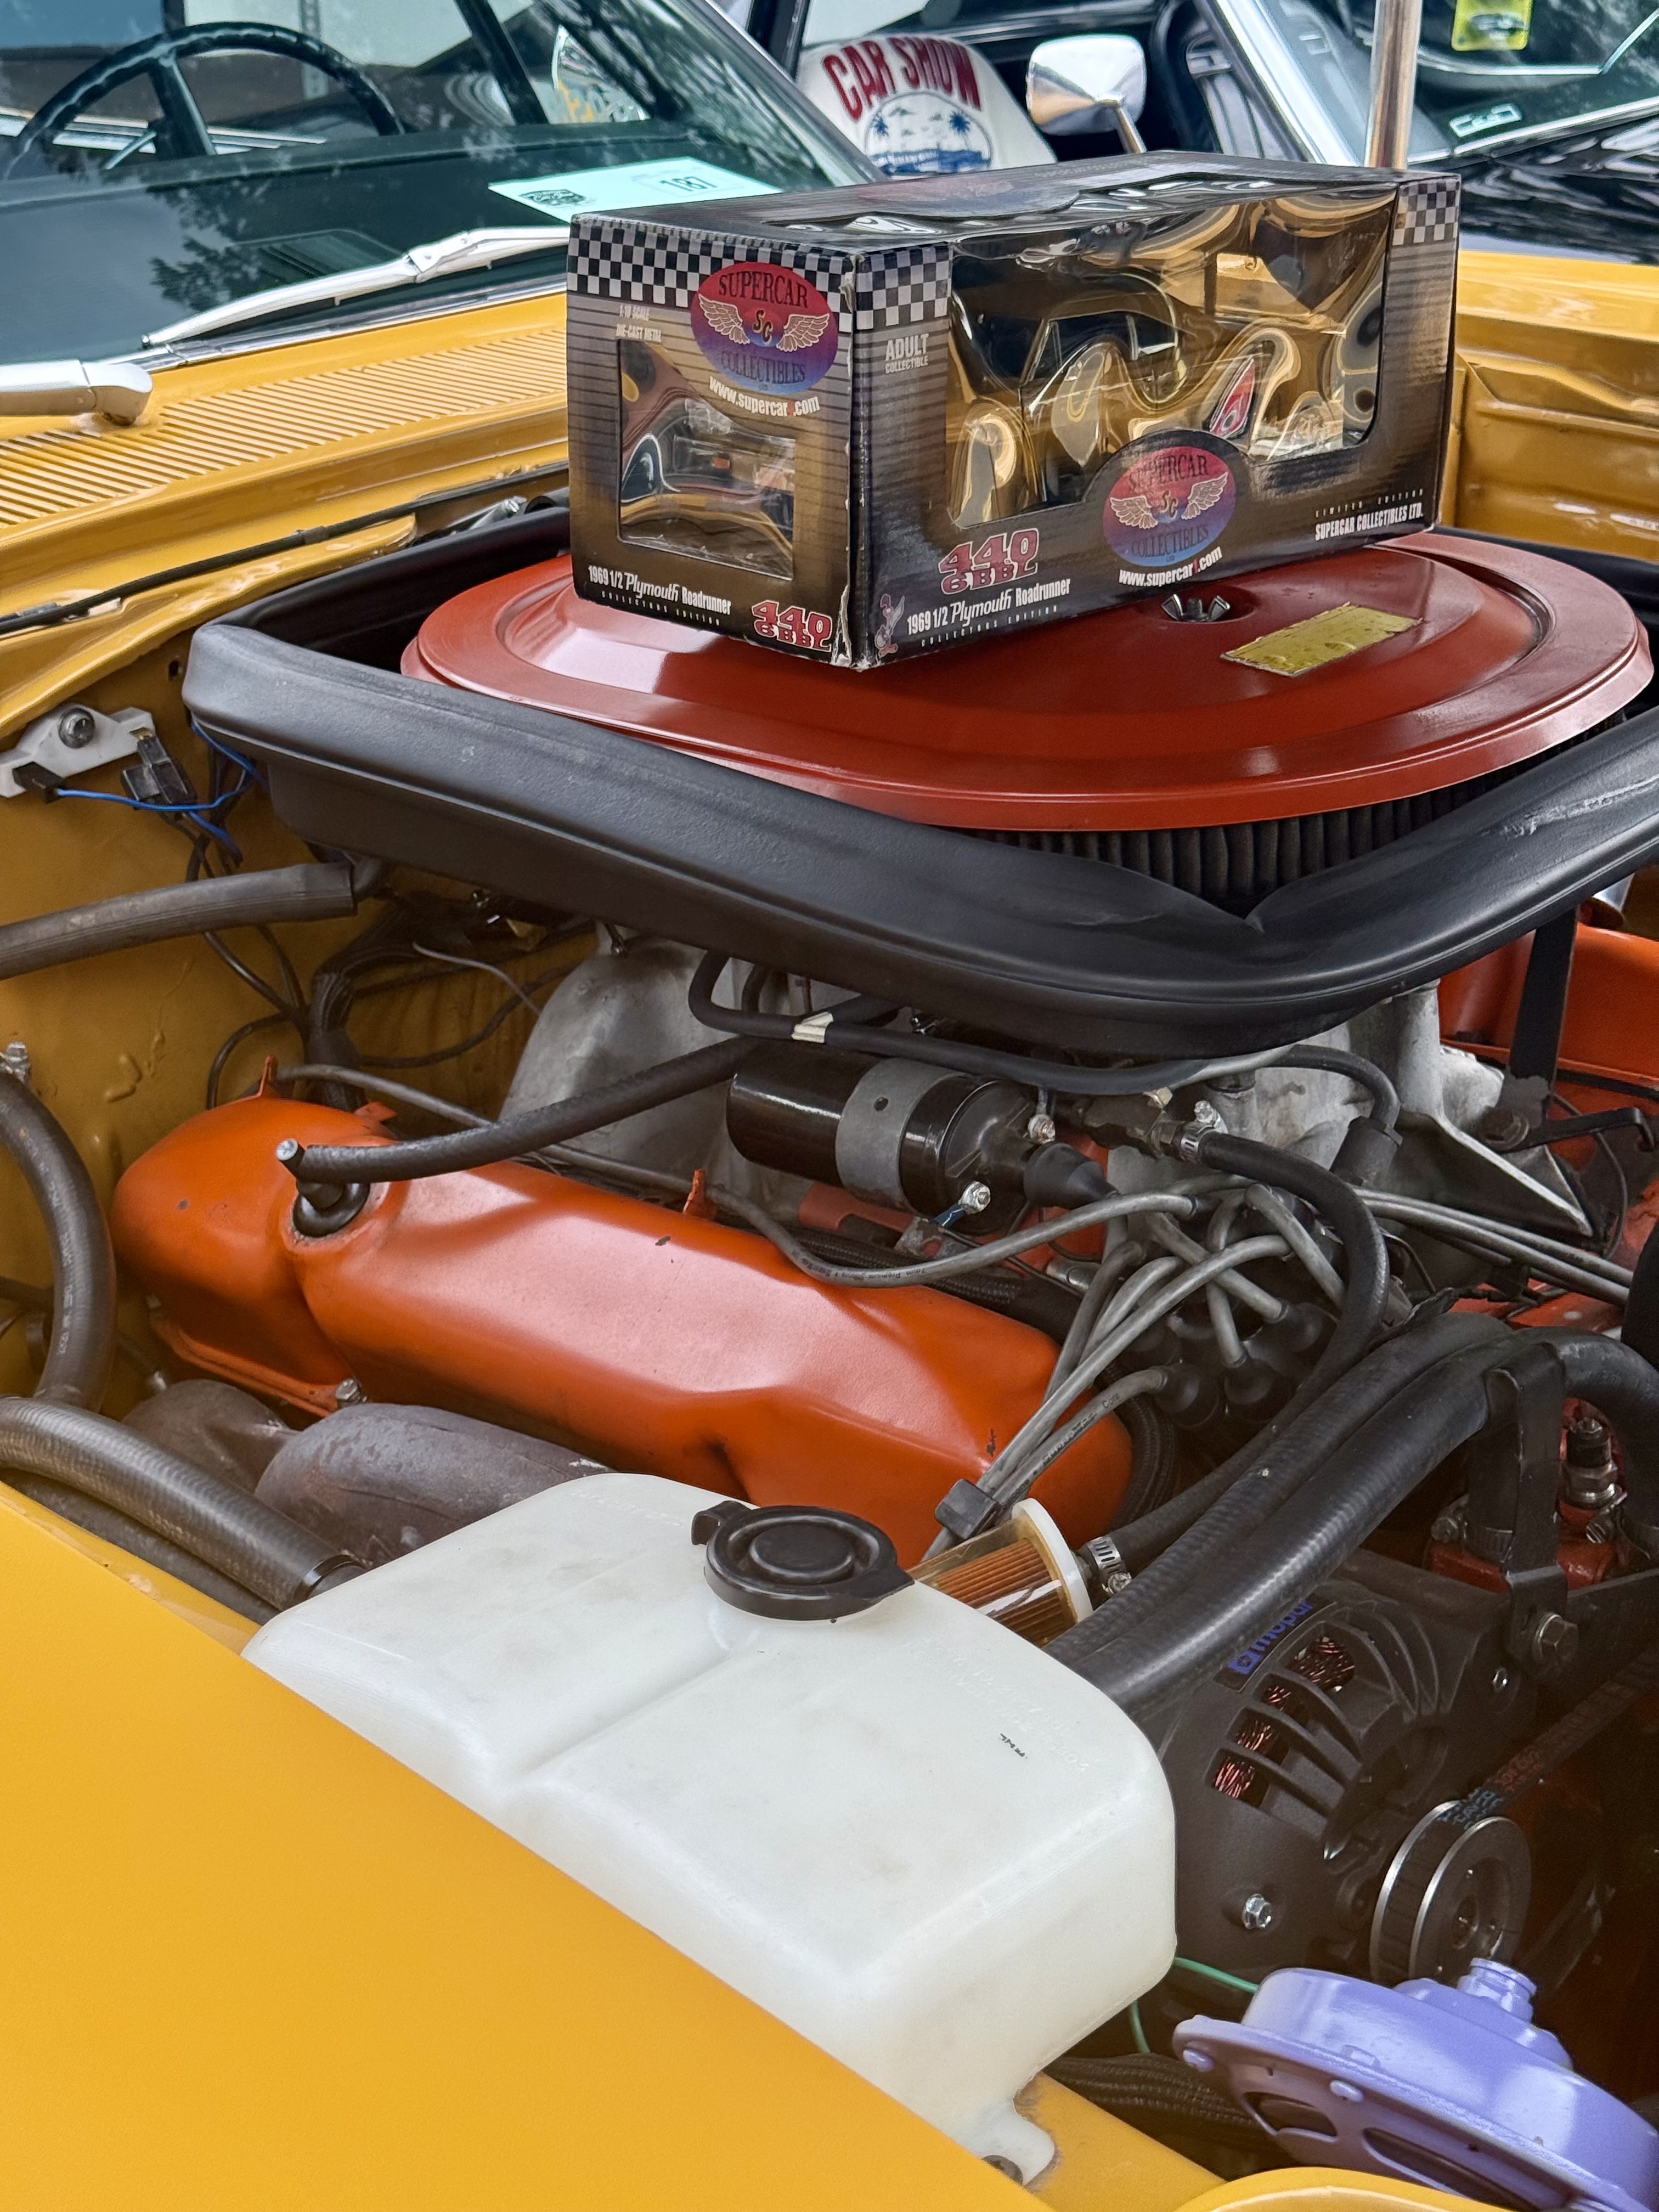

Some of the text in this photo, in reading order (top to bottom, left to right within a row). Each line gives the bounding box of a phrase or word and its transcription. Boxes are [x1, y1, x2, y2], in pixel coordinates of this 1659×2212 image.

[822, 36, 981, 122] CAR SHOW
[659, 176, 718, 192] 187
[718, 270, 808, 308] SUPERCAR
[885, 333, 929, 362] ADULT
[885, 355, 928, 374] COLLECTIBLE
[720, 351, 806, 384] COLLECTIBLES
[1128, 454, 1208, 490] SUPERCAR
[1315, 502, 1423, 541] SUPERCAR COLLECTIBLES LTD.
[938, 527, 1040, 573] 440
[1131, 524, 1209, 558] COLLECTIBLES
[1119, 546, 1223, 587] www.supercar1.com
[588, 565, 731, 615] 1969 1/2 Plymouth Roadrunner
[907, 578, 1070, 635] 1969 1/2 Plymouth Roadrunner
[752, 600, 833, 639] 440
